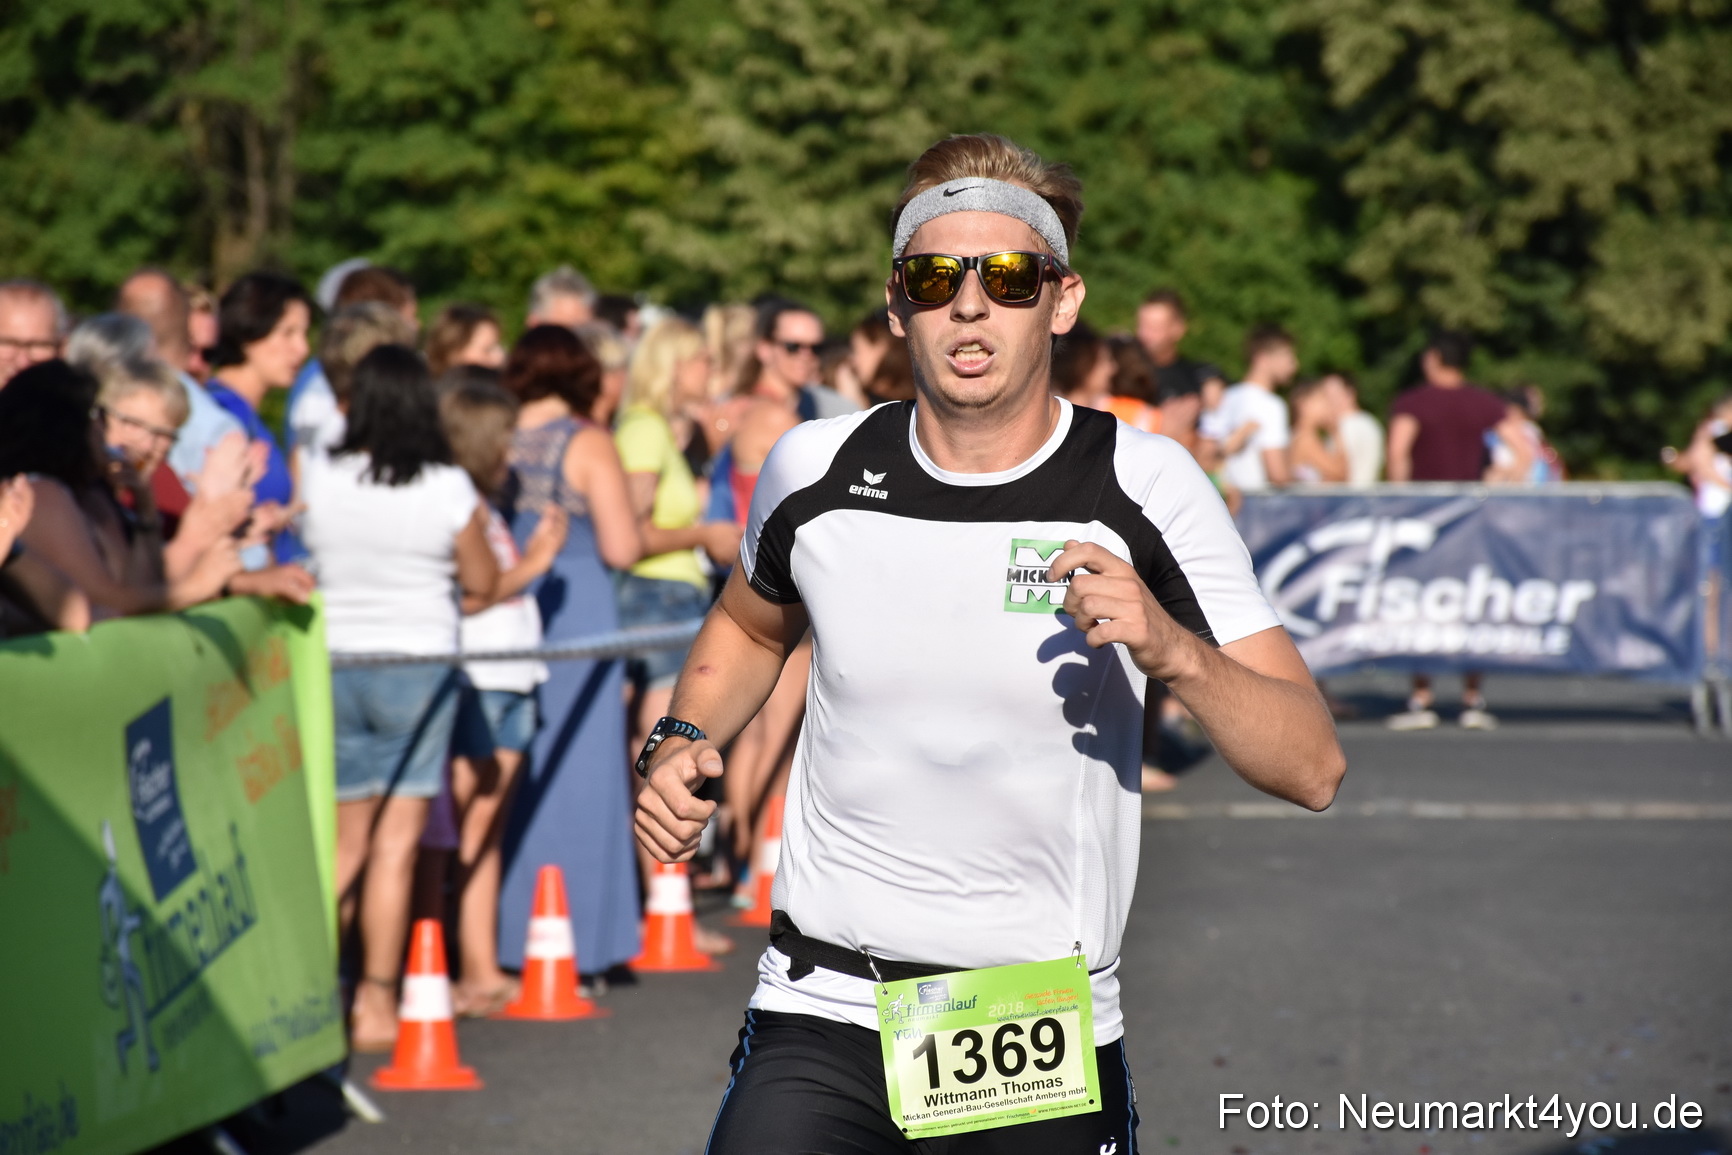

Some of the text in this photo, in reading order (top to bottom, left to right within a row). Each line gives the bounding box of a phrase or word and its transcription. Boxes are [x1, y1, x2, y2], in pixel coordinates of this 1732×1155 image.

[848, 484, 889, 500] erima
[1315, 562, 1597, 625] Fischer
[906, 994, 978, 1017] firmenlauf
[988, 1001, 1024, 1017] 2018
[912, 1016, 1066, 1090] 1369
[902, 1086, 1088, 1122] Mickan General-Bau-Gesellschaft Amberg mbH
[924, 1076, 1064, 1108] Wittmann Thomas
